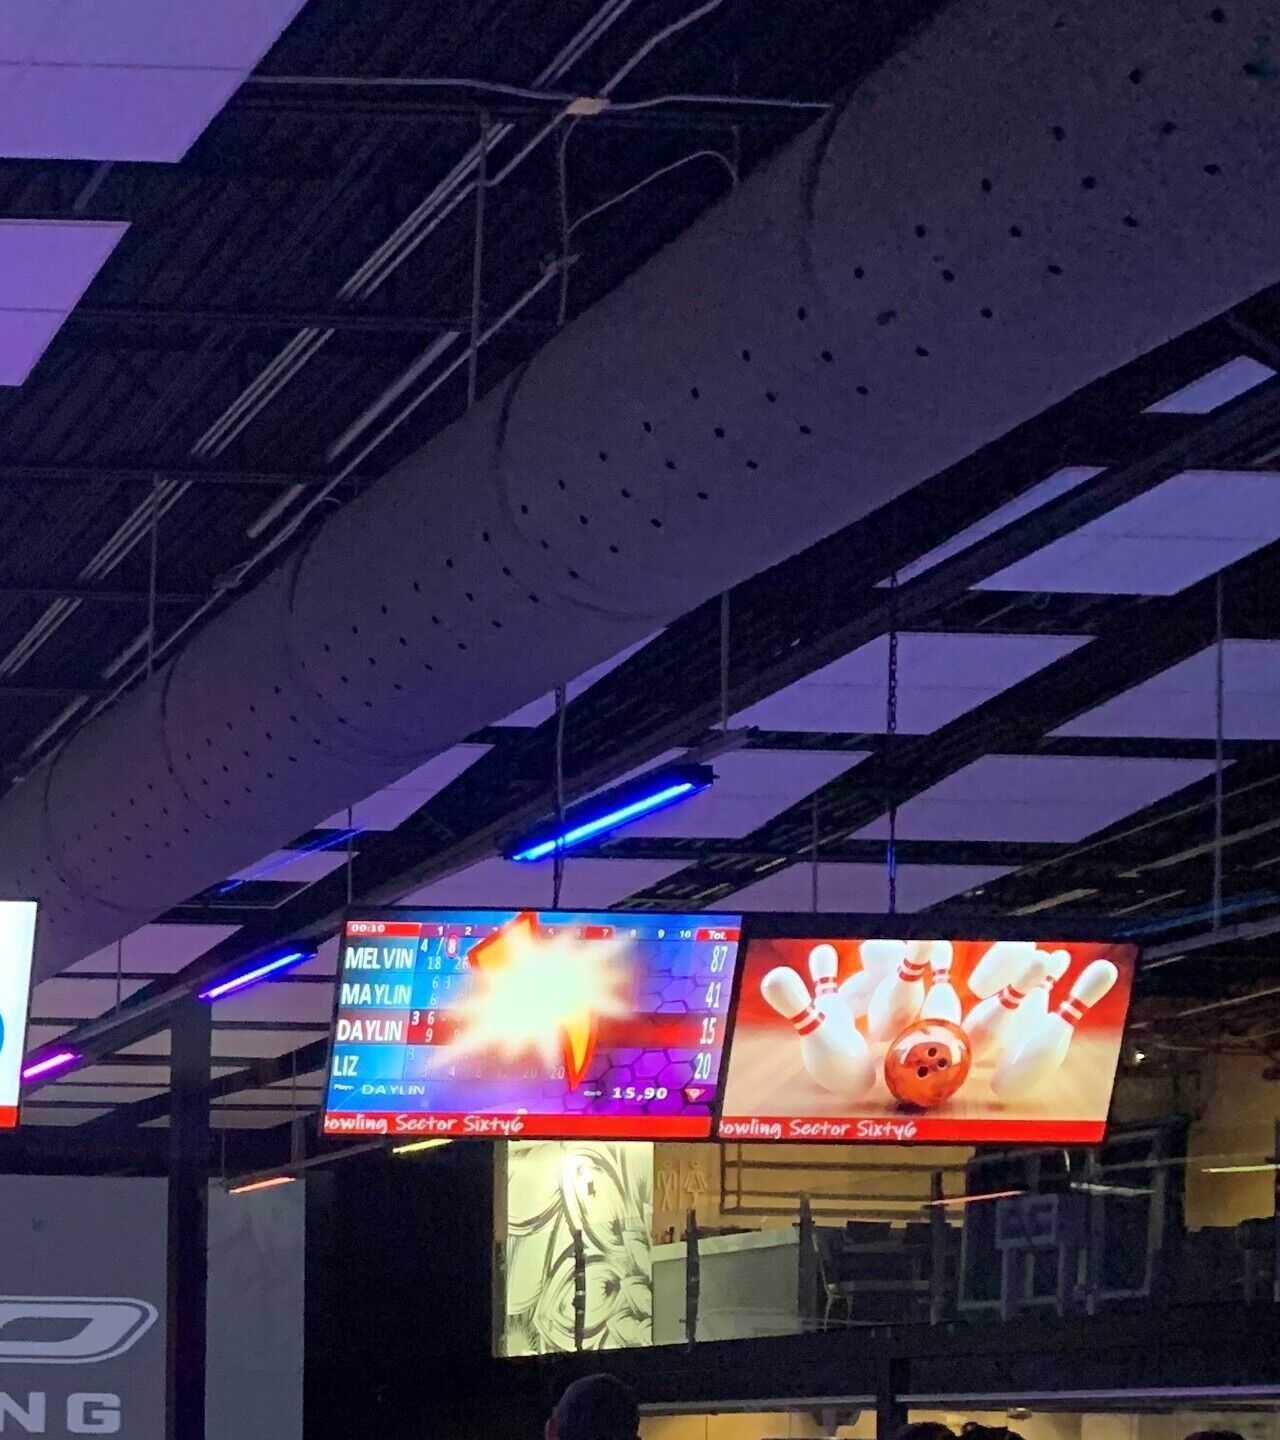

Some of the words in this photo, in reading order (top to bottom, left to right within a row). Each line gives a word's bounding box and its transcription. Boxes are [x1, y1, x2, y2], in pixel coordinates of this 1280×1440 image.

[437, 926, 444, 935] 1
[465, 926, 472, 935] 2
[657, 930, 665, 939] 9
[679, 930, 691, 939] 10
[345, 947, 414, 970] MELVIN
[711, 946, 728, 973] 87
[341, 984, 412, 1006] MAYLIN
[706, 982, 721, 1009] 41
[337, 1019, 403, 1042] DAYLIN
[700, 1018, 717, 1045] 15
[333, 1056, 359, 1077] LIZ
[694, 1053, 711, 1080] 20
[362, 1084, 425, 1095] DAYLIN
[395, 1114, 459, 1131] Sector
[463, 1114, 524, 1135] Sixty6
[790, 1119, 850, 1136] Sector
[857, 1120, 918, 1140] Sixty6
